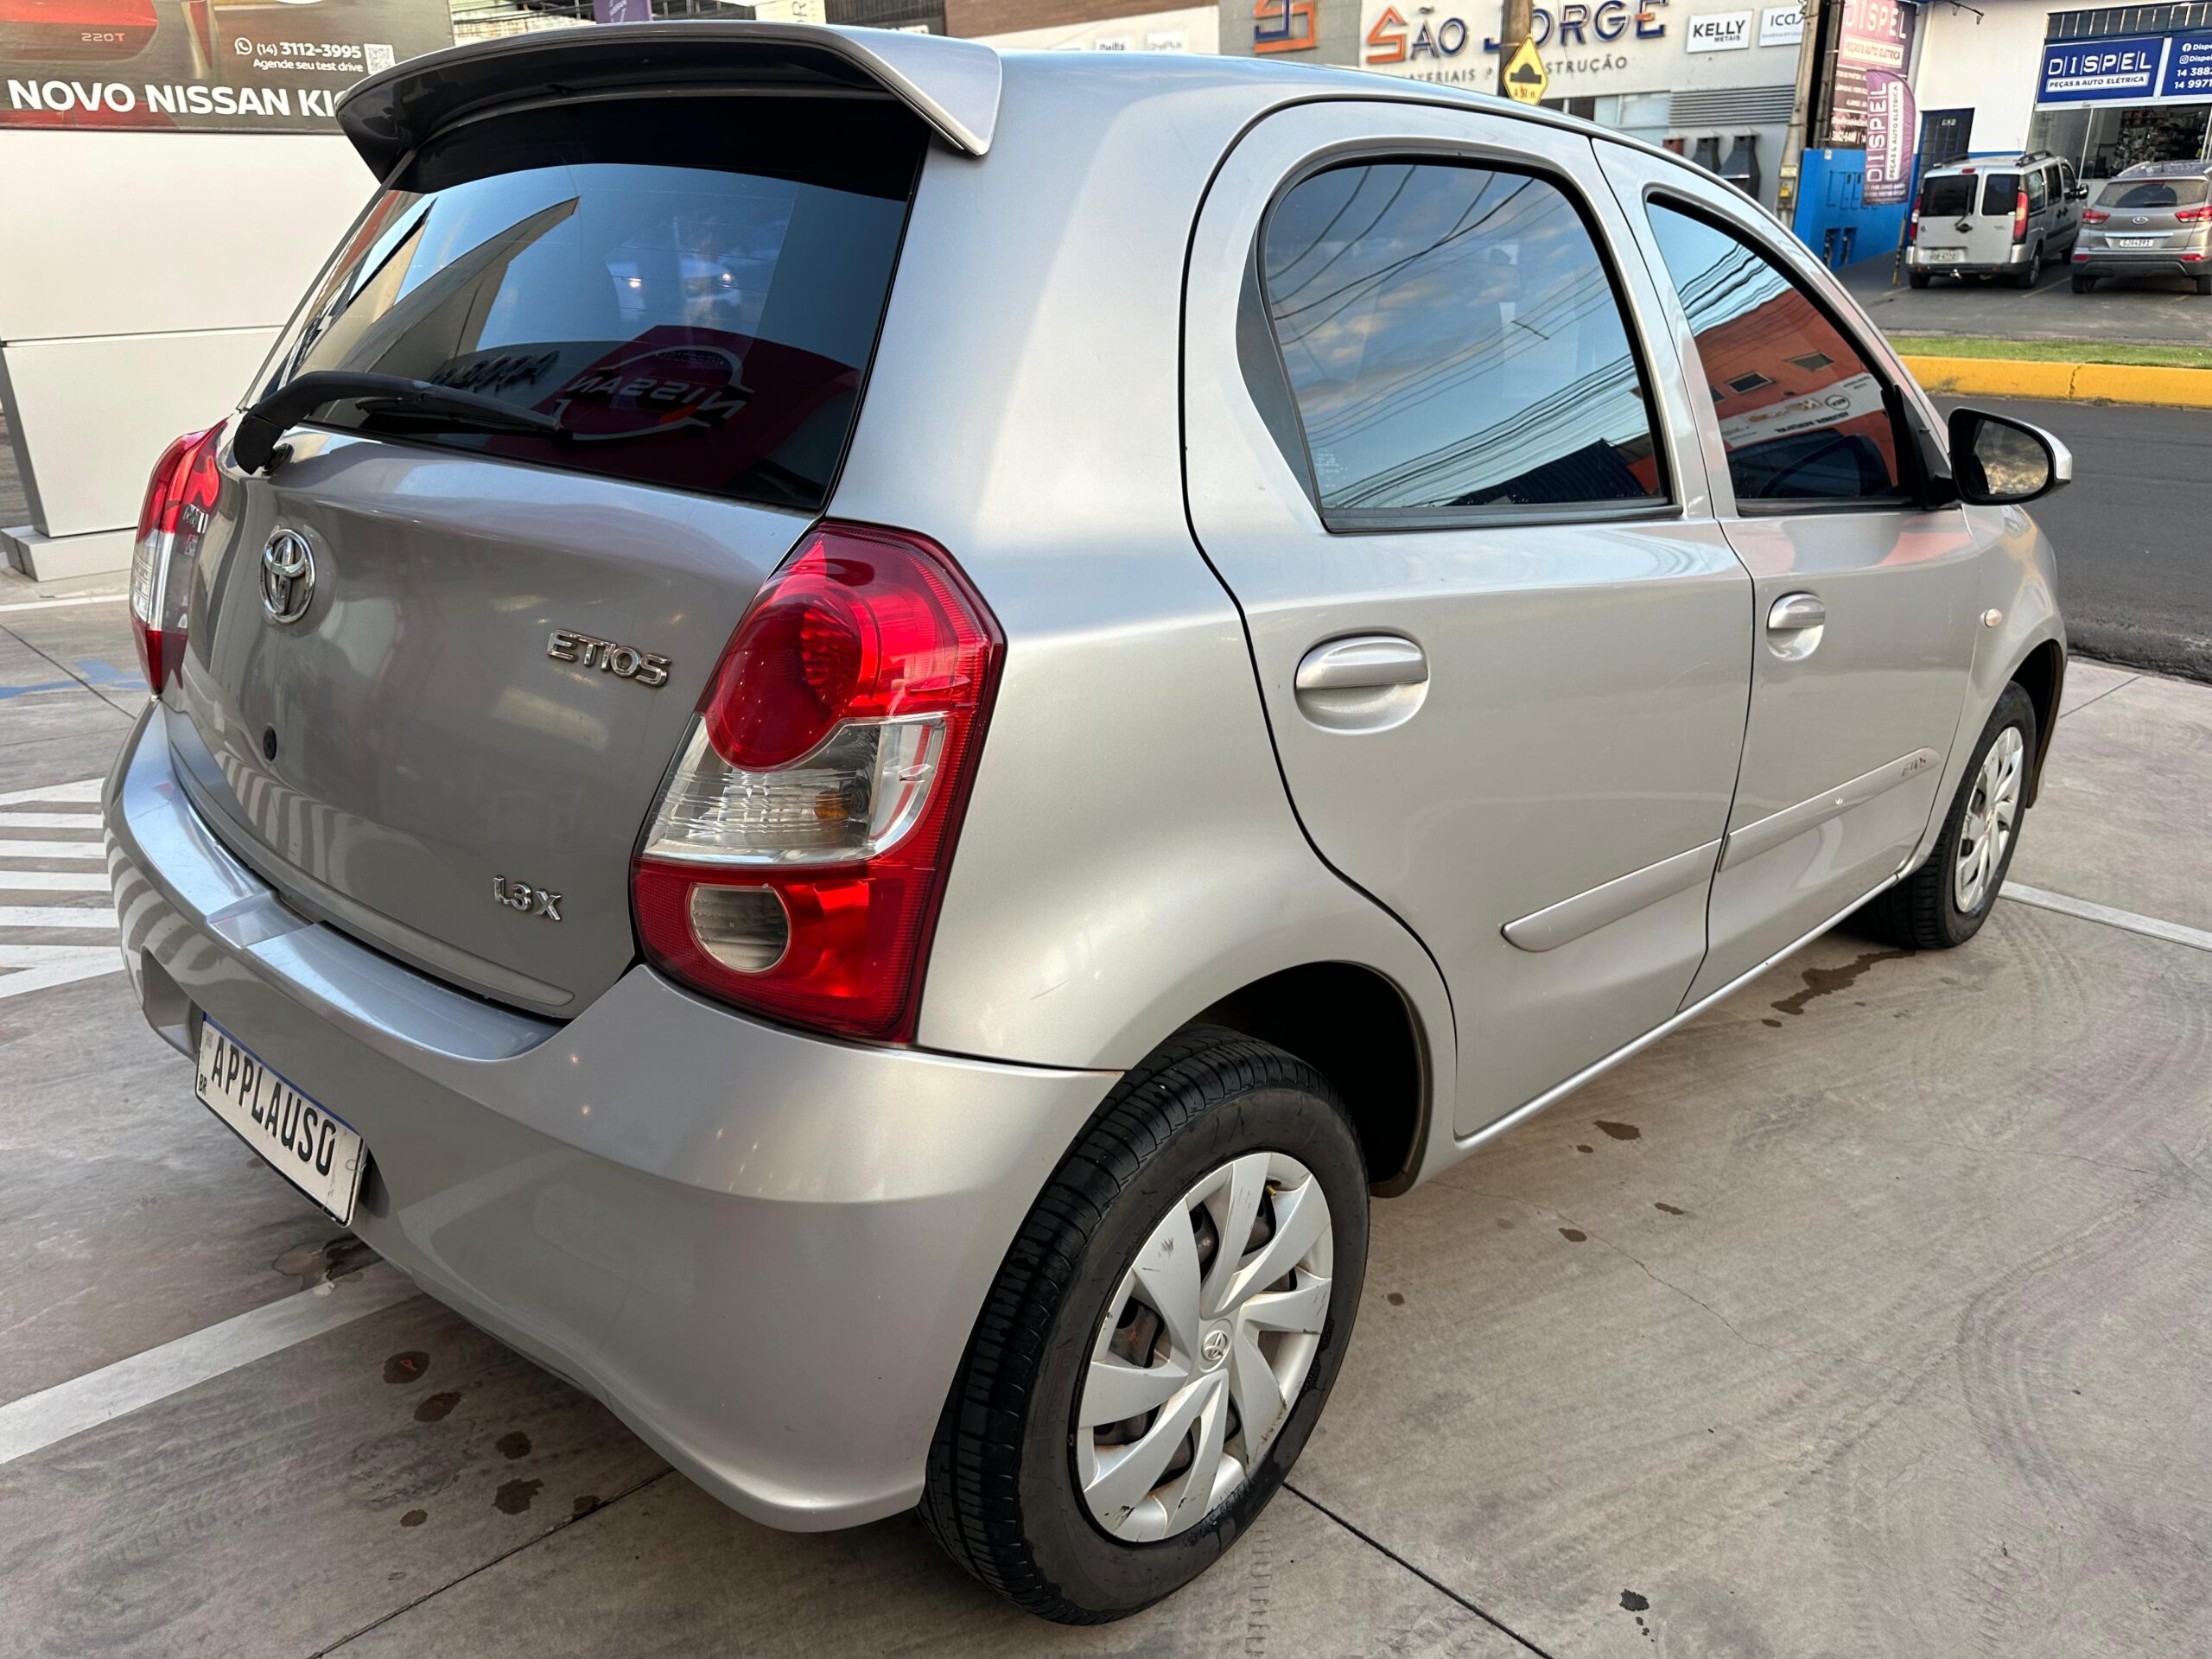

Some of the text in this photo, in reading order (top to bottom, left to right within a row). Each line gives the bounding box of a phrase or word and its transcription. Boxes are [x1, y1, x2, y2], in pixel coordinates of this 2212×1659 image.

[81, 33, 125, 41] 220T
[1366, 6, 1467, 64] SÃO
[1693, 20, 1745, 38] KELLY
[257, 42, 361, 58] (14) 3112-3995
[253, 59, 363, 73] Agende seu test drive
[1545, 55, 1628, 76] STRUÇÃO
[2047, 51, 2152, 76] DISPEL
[2106, 75, 2144, 85] ELÉTRICA
[7, 79, 344, 118] NOVO NISSAN KI
[1866, 82, 1888, 182] DISPEL
[546, 628, 672, 687] ETIOS
[199, 1073, 207, 1096] BR
[211, 1035, 337, 1177] APPLAUSO
